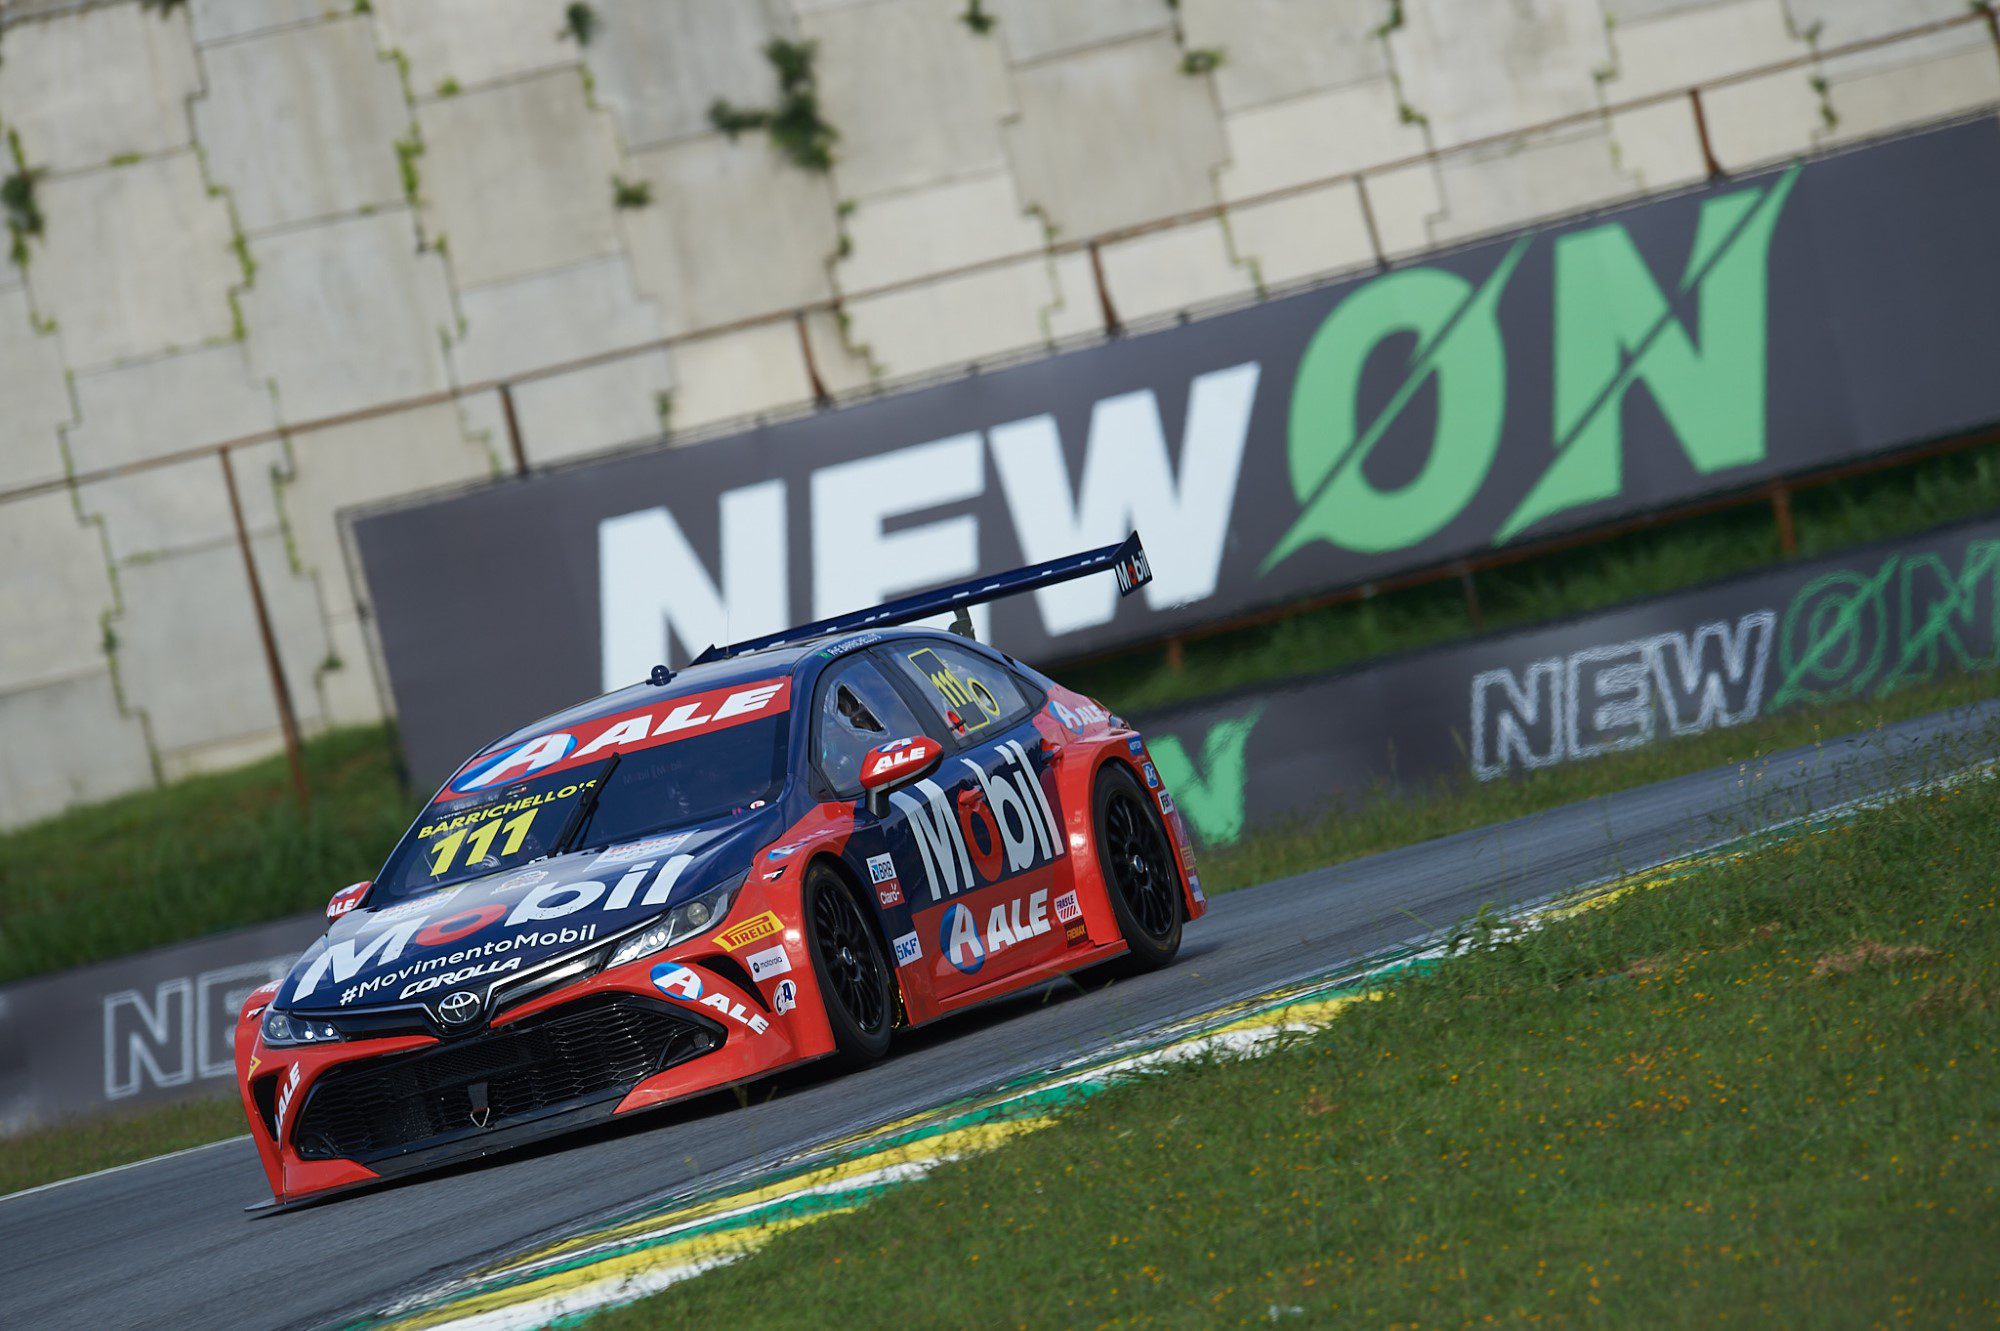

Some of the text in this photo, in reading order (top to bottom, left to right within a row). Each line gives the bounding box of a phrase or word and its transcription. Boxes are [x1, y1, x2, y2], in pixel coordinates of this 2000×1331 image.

[1115, 549, 1152, 592] Mobil
[931, 667, 975, 708] 111
[570, 683, 784, 759] ALE
[872, 747, 926, 773] ALE
[888, 740, 1064, 900] Mobil
[430, 808, 539, 876] 111
[879, 861, 894, 879] BRB
[292, 853, 695, 1003] Mobil
[722, 915, 776, 947] PIRELLI
[986, 888, 1051, 952] ALE
[340, 924, 596, 1006] #MovimentoMobil
[896, 937, 917, 960] SKF
[399, 957, 522, 1000] COROLLA
[700, 993, 770, 1035] ALE
